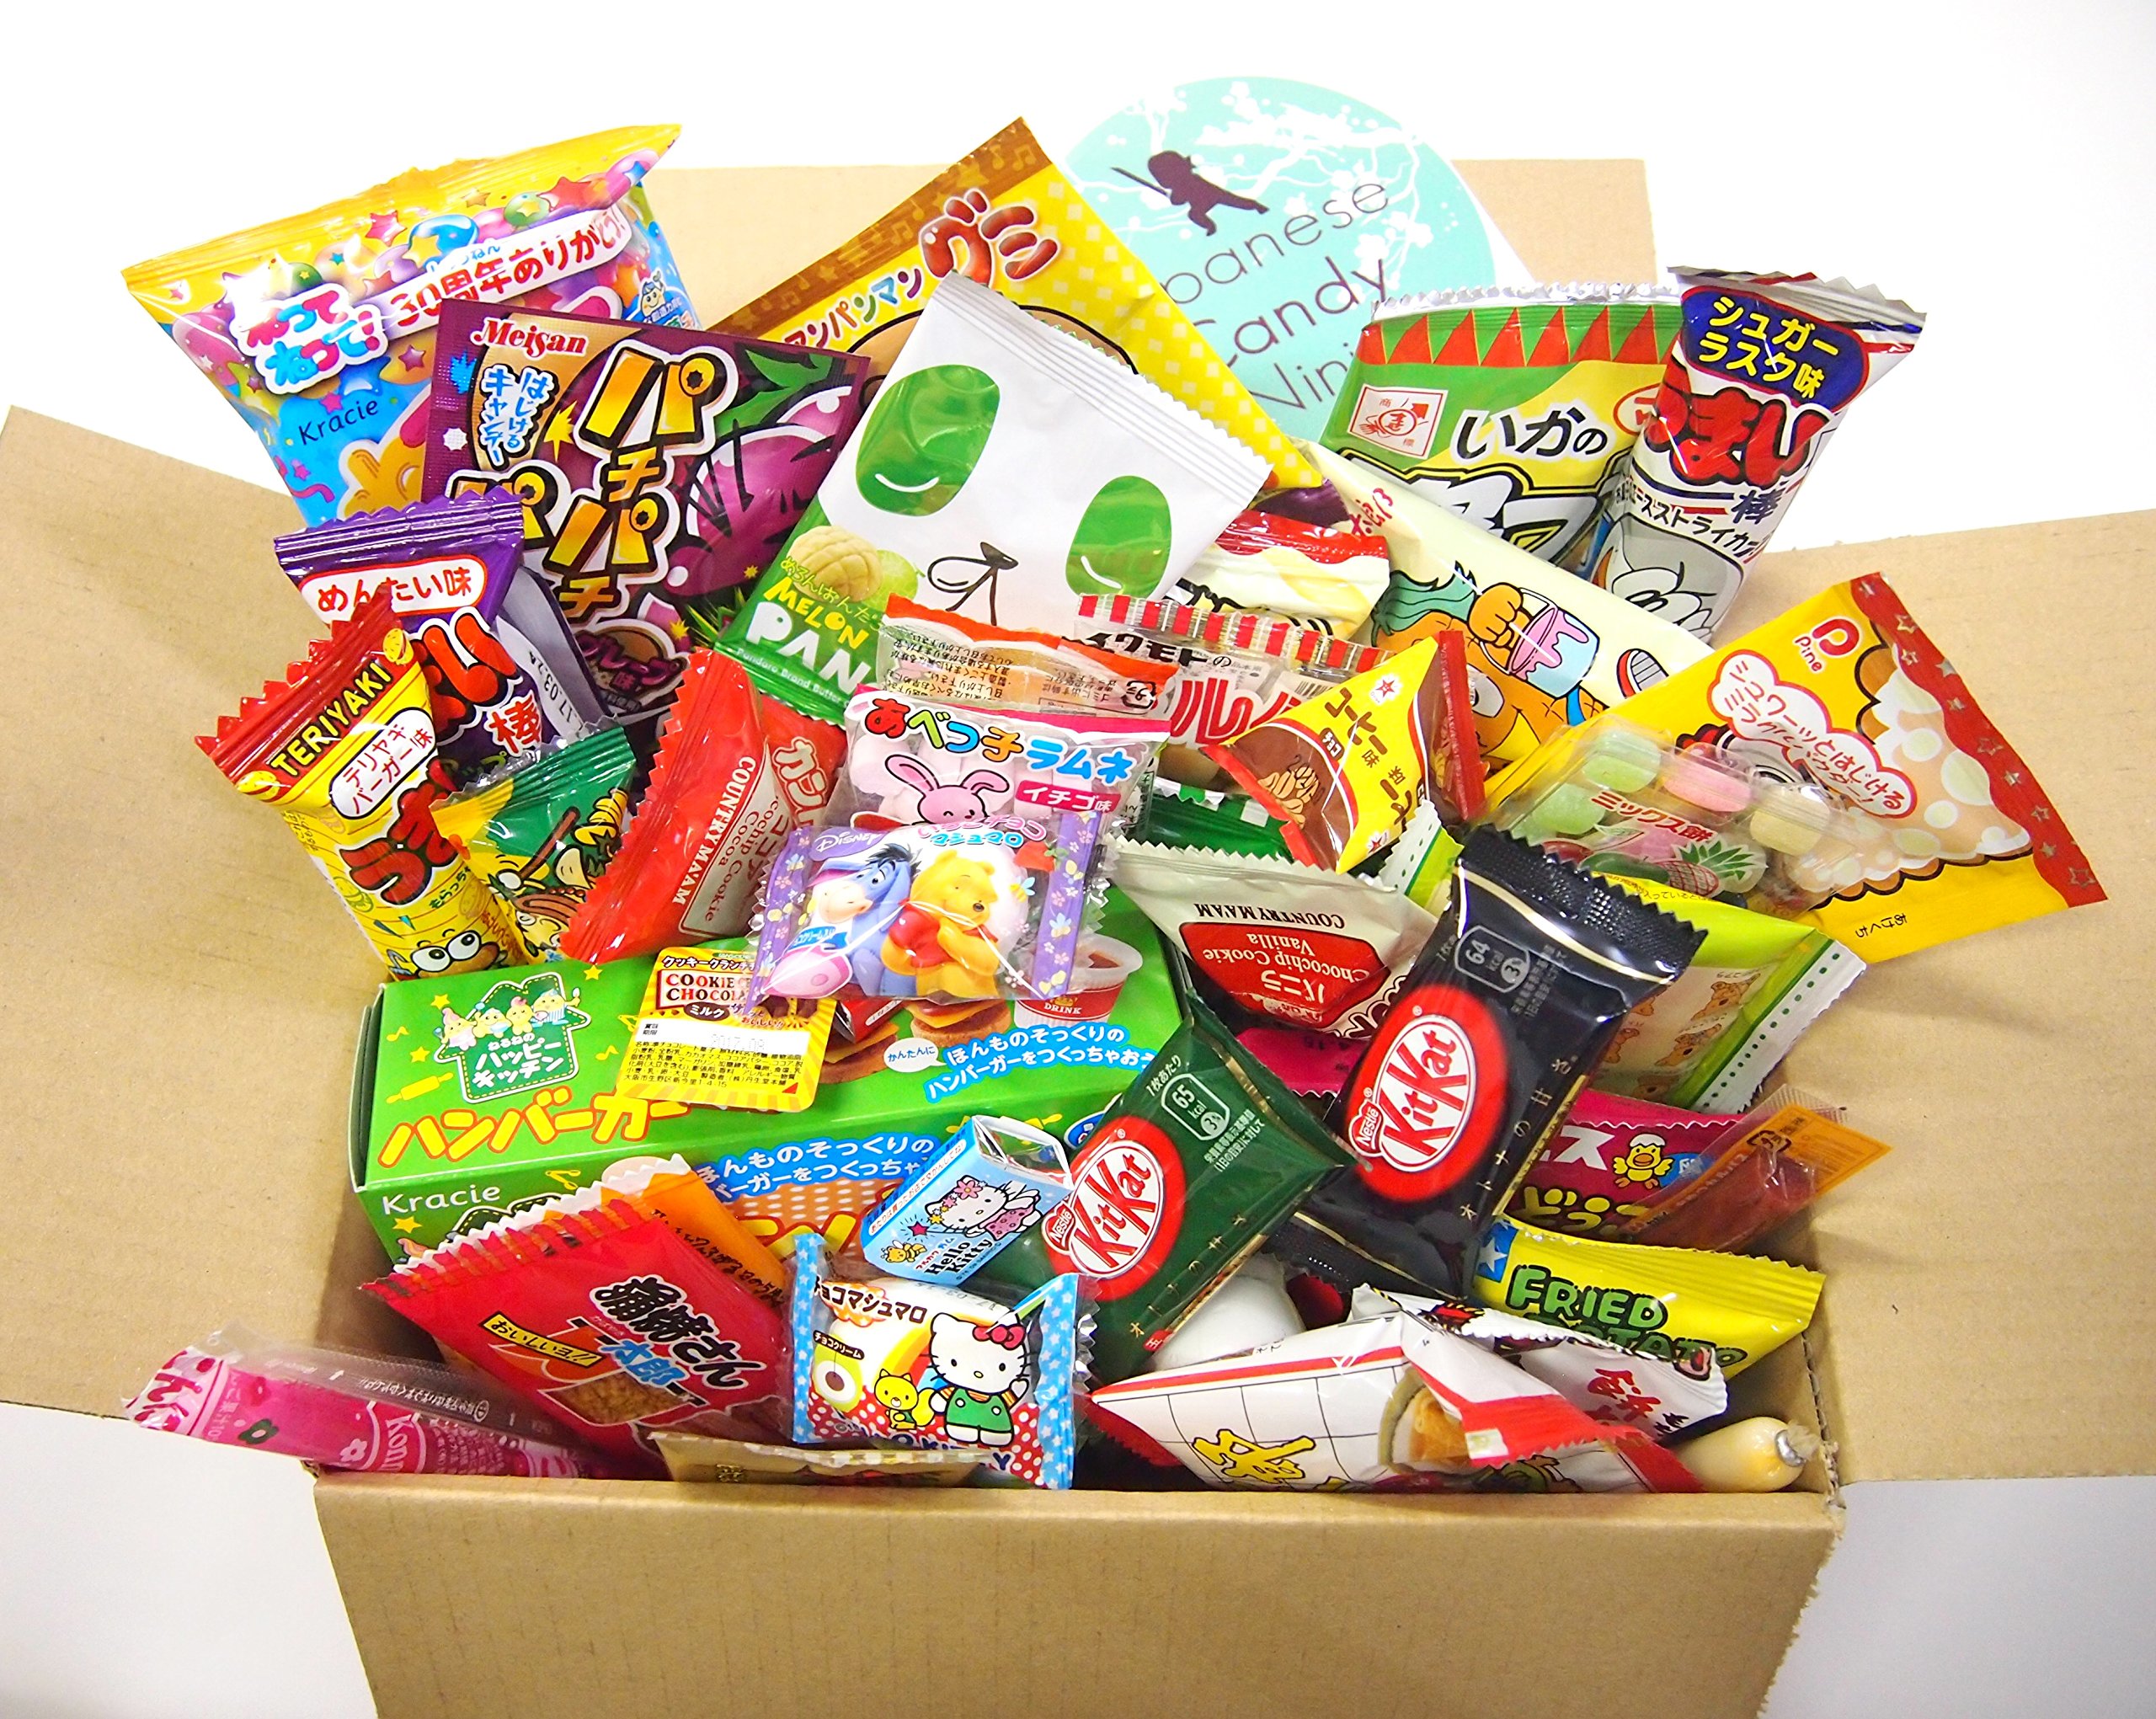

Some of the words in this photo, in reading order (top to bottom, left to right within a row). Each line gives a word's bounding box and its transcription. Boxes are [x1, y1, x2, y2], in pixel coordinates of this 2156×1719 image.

[921, 186, 1060, 287] グミ
[1160, 181, 1389, 304] panese
[1710, 296, 1839, 357] シュガー
[1248, 341, 1356, 410] Vin
[1699, 330, 1828, 399] ラスク味
[298, 397, 379, 446] Kracie
[509, 370, 553, 452] はじける
[1456, 407, 1609, 460] いかの
[763, 576, 870, 650] MELON
[745, 601, 873, 696] PAN
[1795, 633, 1824, 673] Pine
[270, 660, 393, 778] TERIYAKI
[488, 692, 545, 756] 棒
[706, 755, 757, 846] COUNTRY
[1021, 786, 1115, 815] イチゴ味
[716, 810, 760, 868] Cocoa
[671, 842, 710, 906] MA'AM
[1194, 903, 1255, 916] MA'AM
[1260, 907, 1346, 929] COUNTRY
[1202, 948, 1271, 965] Cookie
[1246, 933, 1314, 956] Vanilla
[1465, 938, 1491, 965] 64
[665, 973, 734, 990] COOKIE
[1260, 969, 1326, 1004] バニラ
[689, 1003, 725, 1020] ミルク
[1043, 1002, 1082, 1016] DRINK
[474, 1040, 563, 1070] ハッピー
[887, 1045, 937, 1064] かんたんに
[947, 1025, 1125, 1067] ほんものそっくりの
[472, 1055, 565, 1089] キッチン
[1381, 1028, 1469, 1157] KitKat
[1171, 1084, 1197, 1109] 65
[1188, 1101, 1209, 1121] kcal
[378, 1085, 691, 1169] ハンバーガー
[1358, 1104, 1380, 1148] Nestlé
[382, 1182, 501, 1216] Kracie
[1073, 1153, 1155, 1268] KitKat
[1049, 1205, 1077, 1243] Nestlé
[926, 1241, 973, 1276] Hello
[945, 1238, 994, 1274] Kitty
[1510, 1268, 1664, 1330] FRIED
[814, 1332, 862, 1359] チョコクリーム
